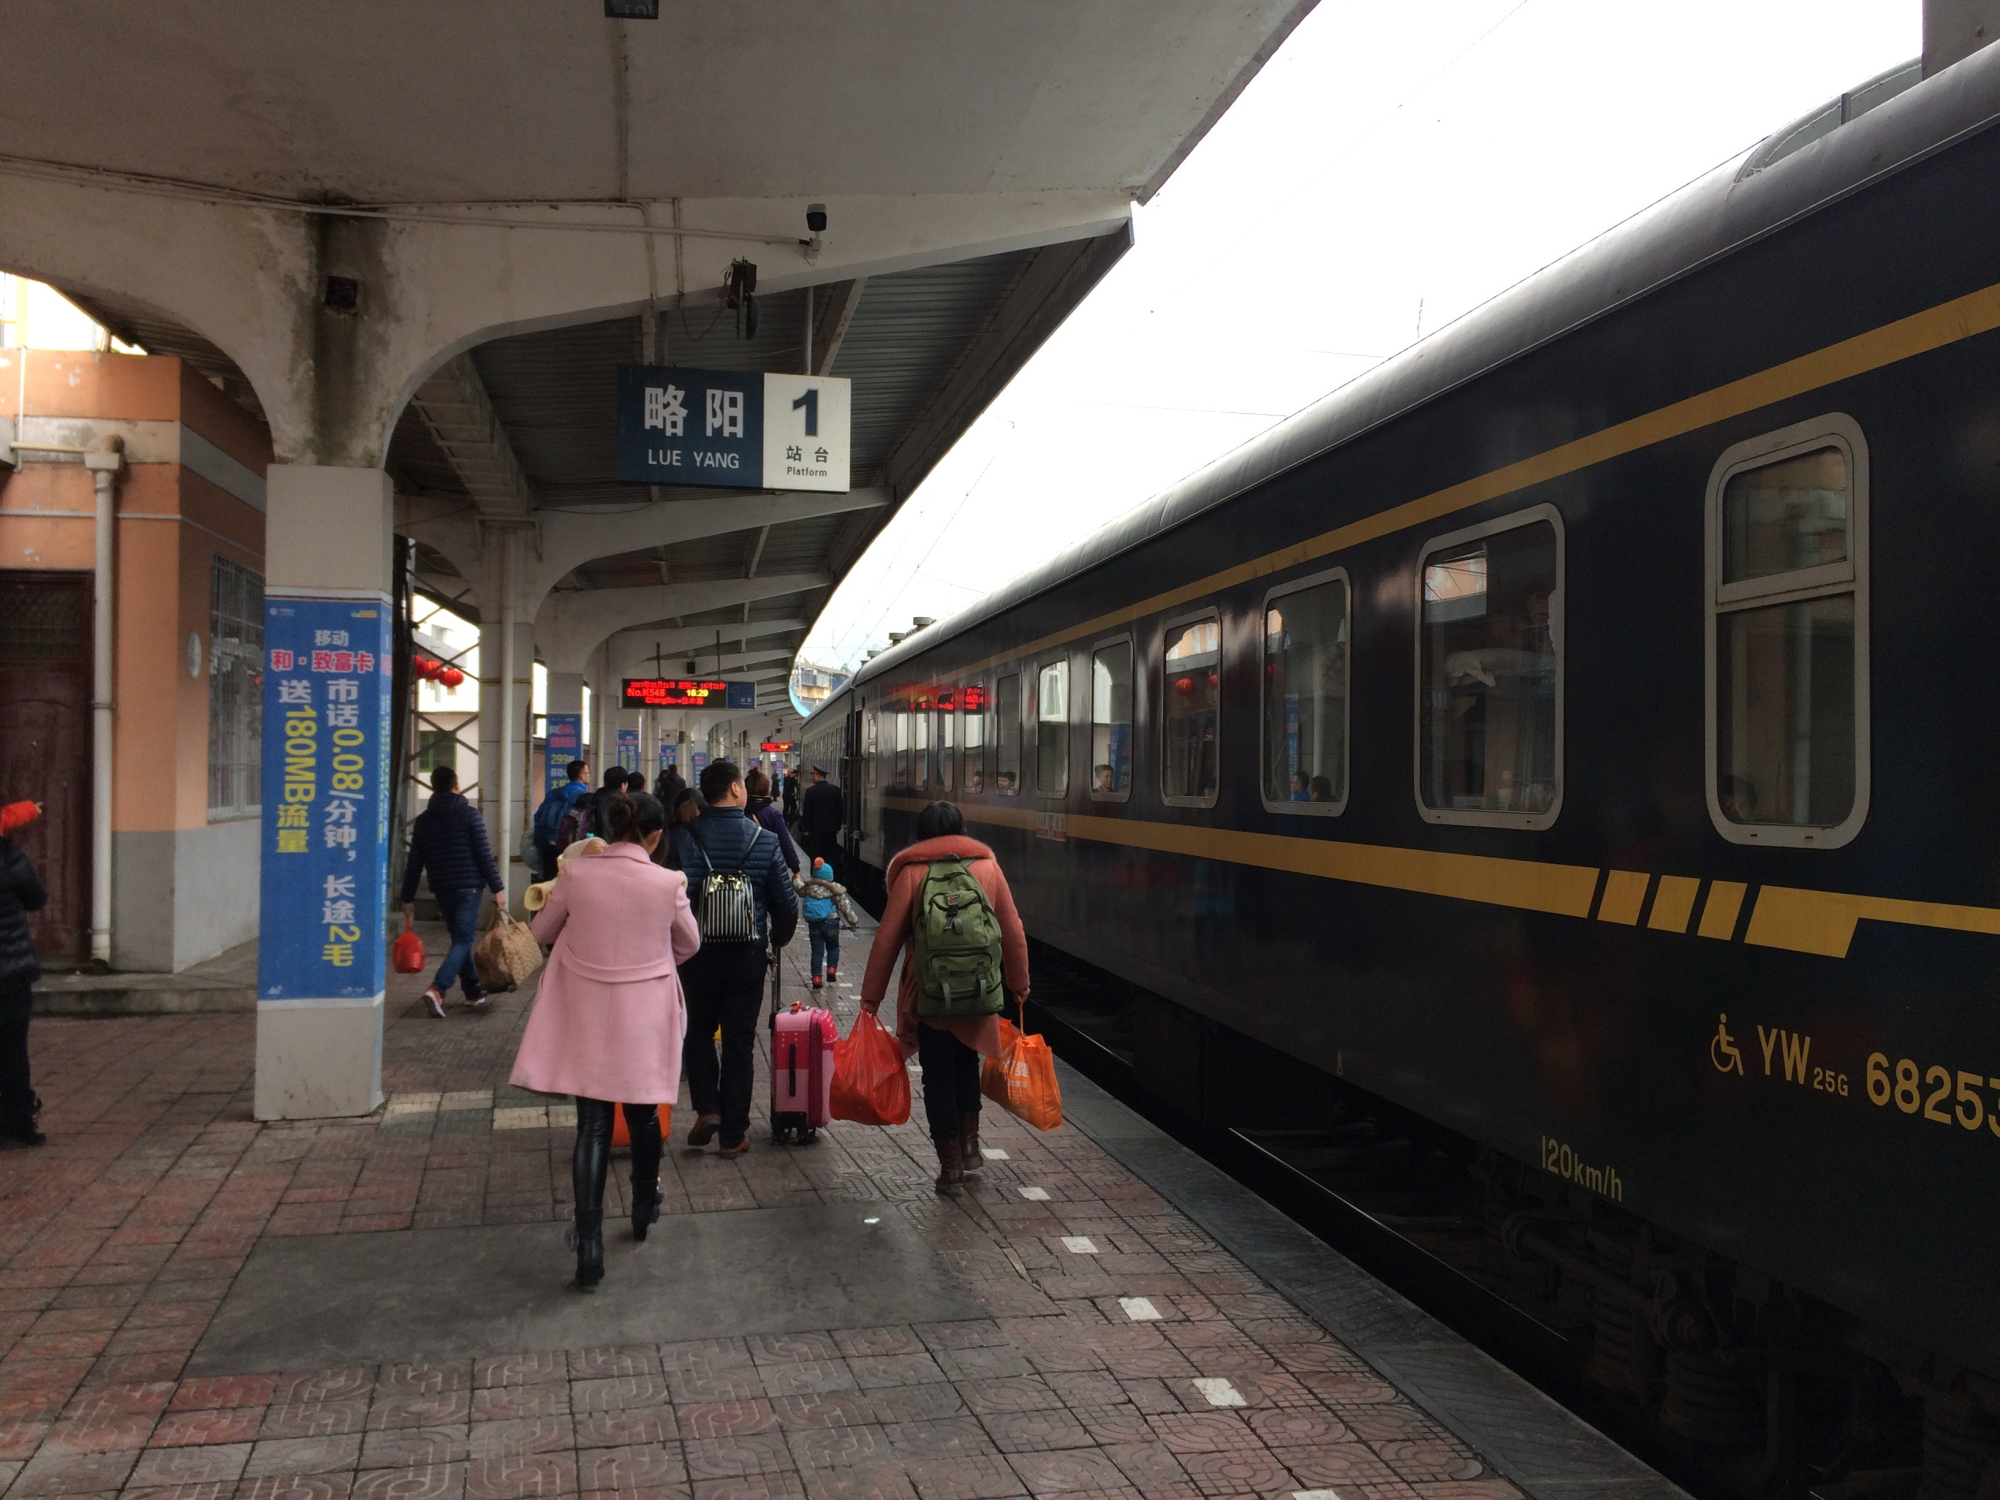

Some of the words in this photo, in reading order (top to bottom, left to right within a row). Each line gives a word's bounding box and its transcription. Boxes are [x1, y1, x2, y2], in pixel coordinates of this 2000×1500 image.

[644, 384, 744, 439] 略阳
[792, 388, 819, 438] 1
[648, 449, 682, 466] LUE
[693, 451, 740, 469] YANG
[786, 445, 829, 464] 站台
[786, 466, 828, 478] Platform
[314, 629, 349, 647] 移动
[276, 679, 317, 853] 送180MB流量
[1756, 1025, 1811, 1085] YW
[1813, 1067, 1849, 1097] 25G
[1541, 1135, 1623, 1203] 120km/h
